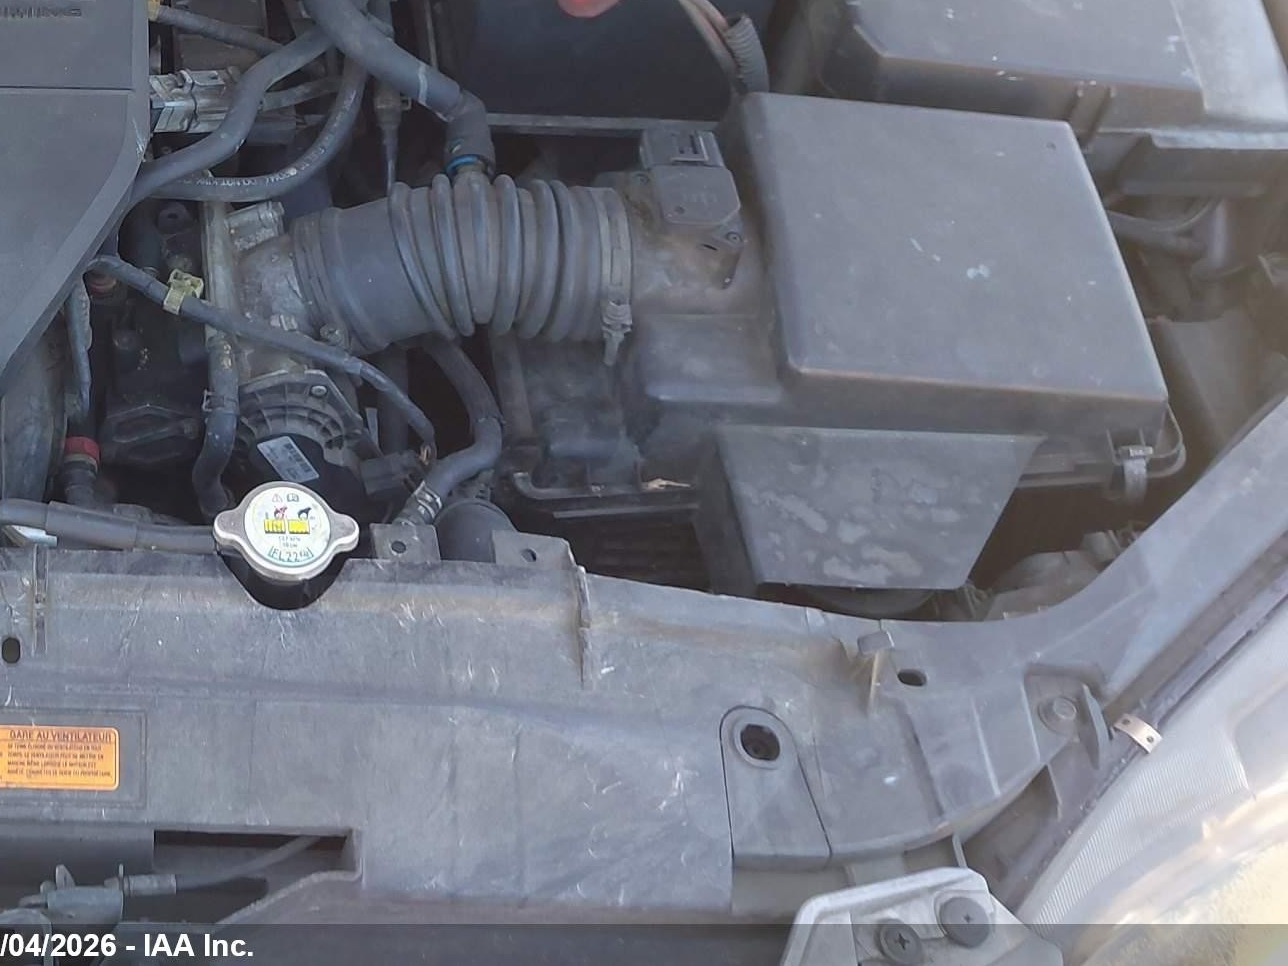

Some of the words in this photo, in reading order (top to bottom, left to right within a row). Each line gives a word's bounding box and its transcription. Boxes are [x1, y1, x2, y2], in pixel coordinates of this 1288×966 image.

[9, 730, 32, 740] GARE
[37, 731, 50, 741] AU
[51, 731, 112, 743] VENTILATEUR
